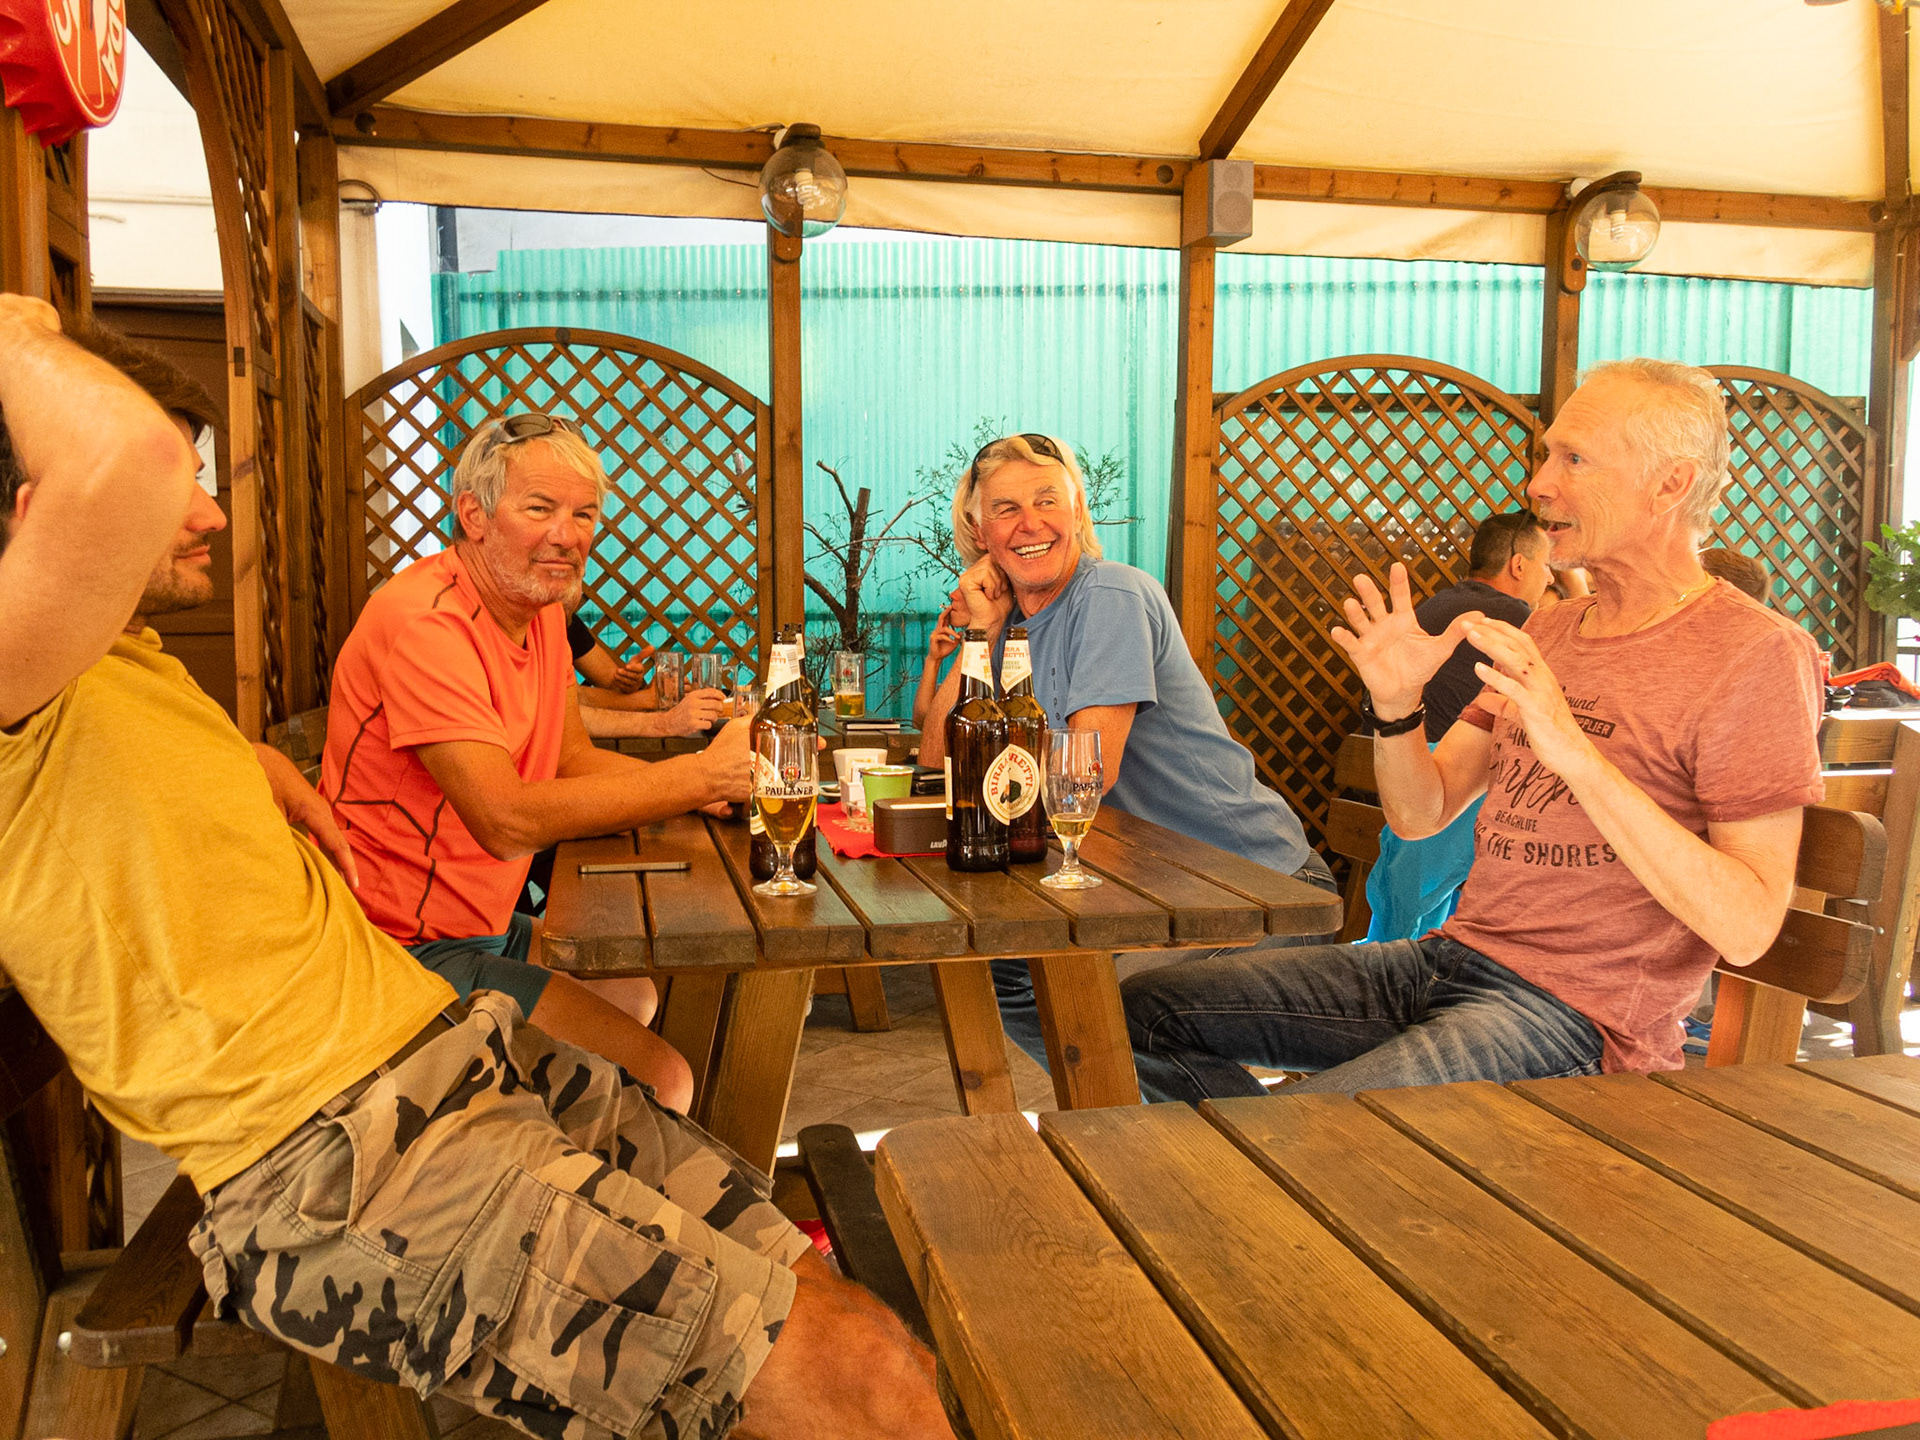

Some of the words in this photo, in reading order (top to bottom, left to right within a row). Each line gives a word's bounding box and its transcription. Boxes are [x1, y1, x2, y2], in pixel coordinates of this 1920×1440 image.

[765, 785, 814, 796] PAULANER
[1494, 809, 1538, 833] BEACHLIFE
[930, 839, 948, 849] LAVA
[1487, 832, 1515, 861] THE
[1523, 841, 1618, 868] SHORES
